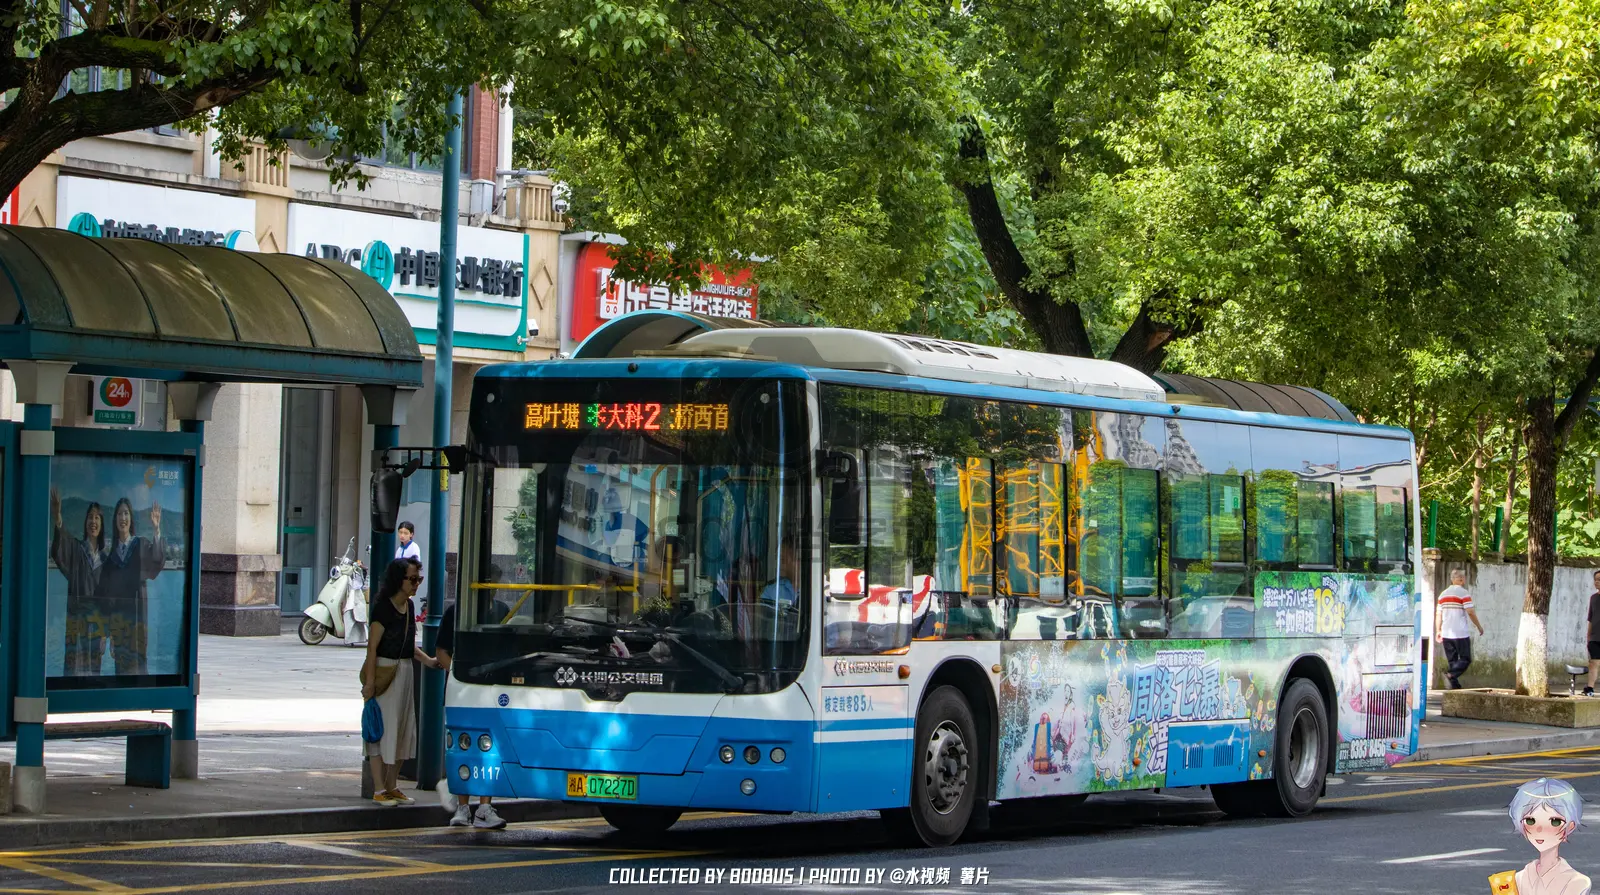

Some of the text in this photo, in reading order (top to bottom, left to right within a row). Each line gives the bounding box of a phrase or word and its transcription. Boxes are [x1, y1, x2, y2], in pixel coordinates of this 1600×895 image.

[394, 246, 524, 297] 中国业银行
[108, 382, 130, 398] 24h
[525, 403, 579, 429] 高叶塘
[580, 671, 663, 685] 长沙公交集团
[473, 765, 501, 780] 8117
